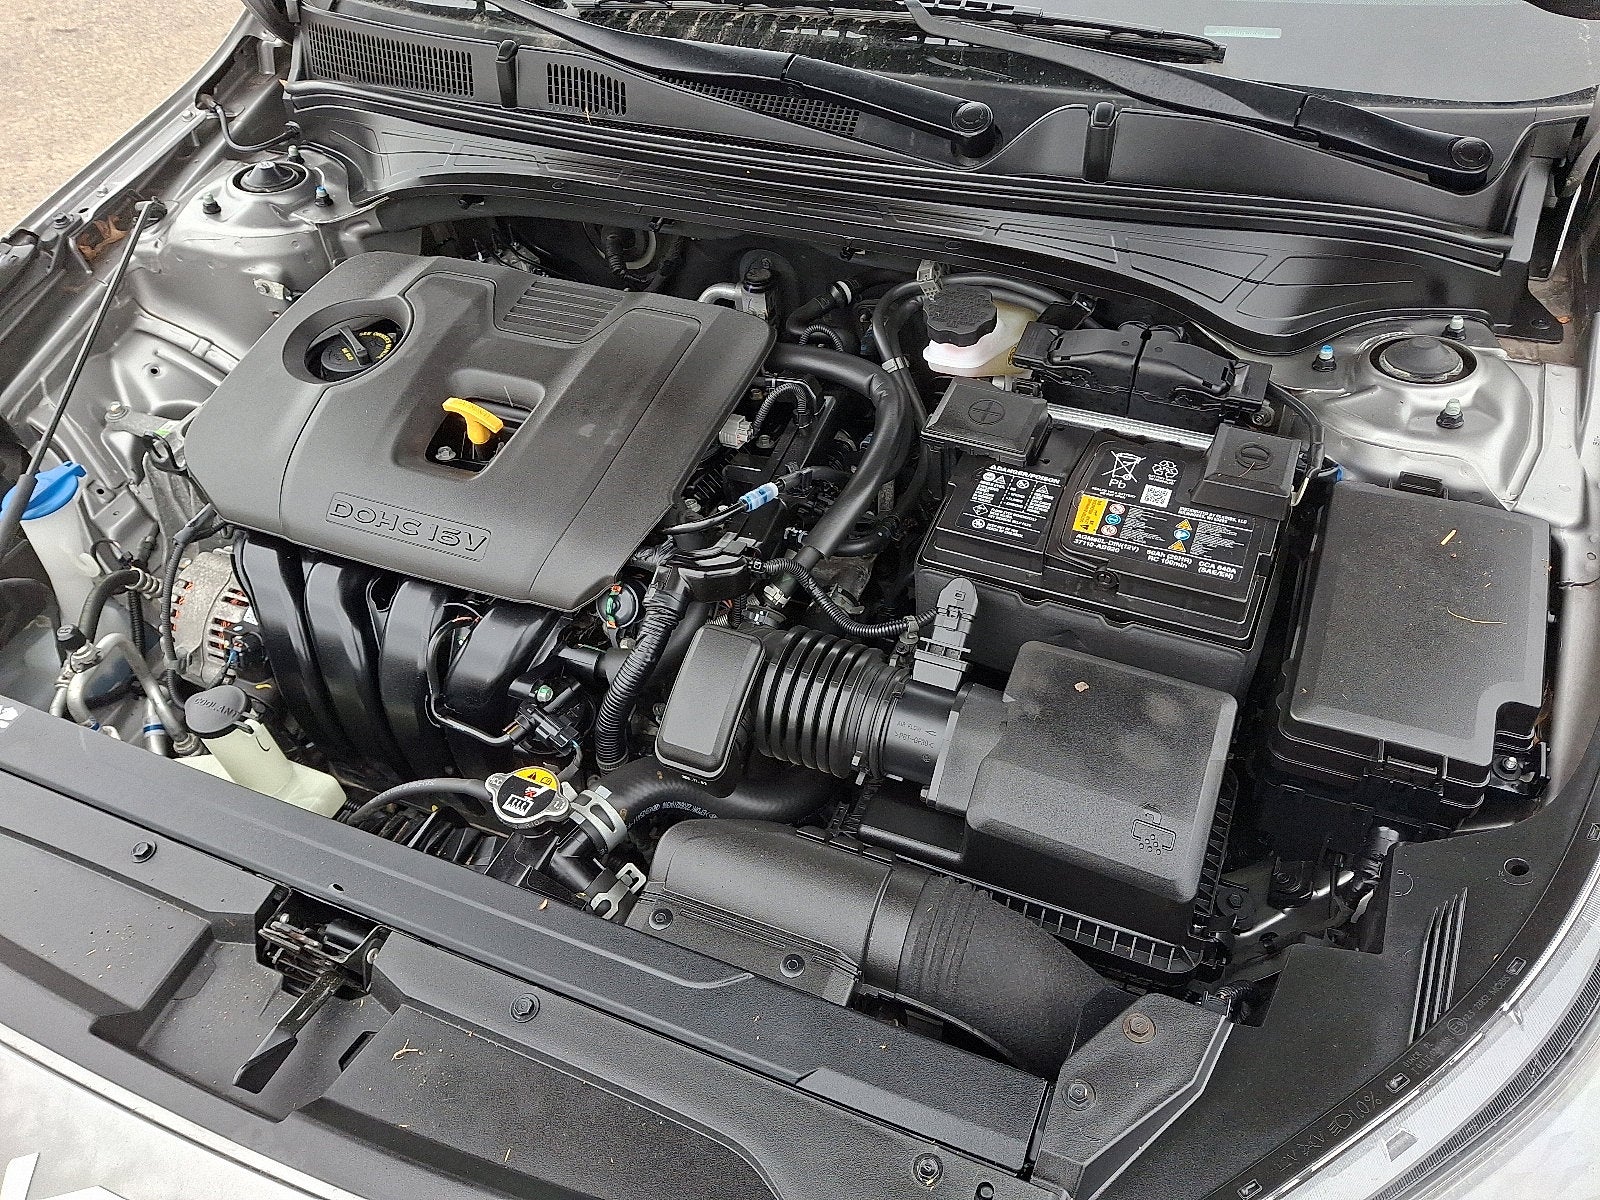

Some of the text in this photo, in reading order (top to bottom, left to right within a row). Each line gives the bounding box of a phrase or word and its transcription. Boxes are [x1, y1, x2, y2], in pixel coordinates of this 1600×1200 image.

[997, 465, 1061, 484] DANGER/POISON
[1108, 478, 1127, 489] Pb
[329, 499, 488, 552] DOHC 16V
[1147, 554, 1160, 563] RC
[194, 697, 241, 719] COOLANT
